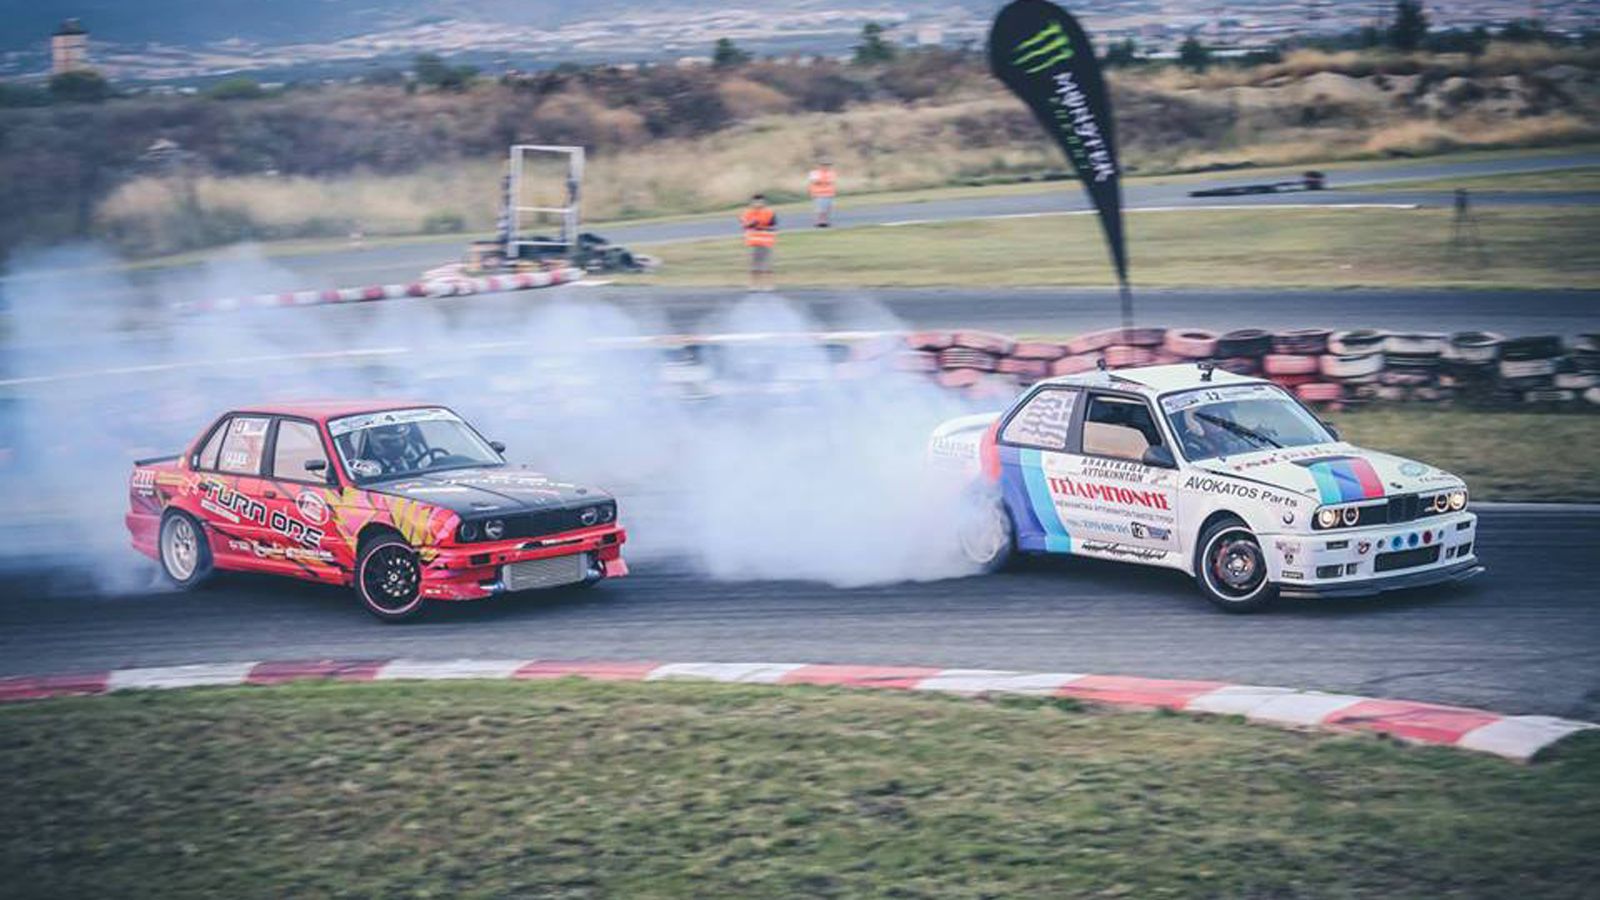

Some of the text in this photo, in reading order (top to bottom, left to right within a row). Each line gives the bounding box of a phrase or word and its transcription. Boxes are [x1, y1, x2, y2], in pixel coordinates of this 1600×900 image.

[1052, 72, 1115, 182] MONSTER
[1205, 391, 1222, 401] 12
[206, 479, 267, 525] TURN
[270, 510, 324, 548] ONE
[1184, 476, 1298, 507] AVOKATOS Parts
